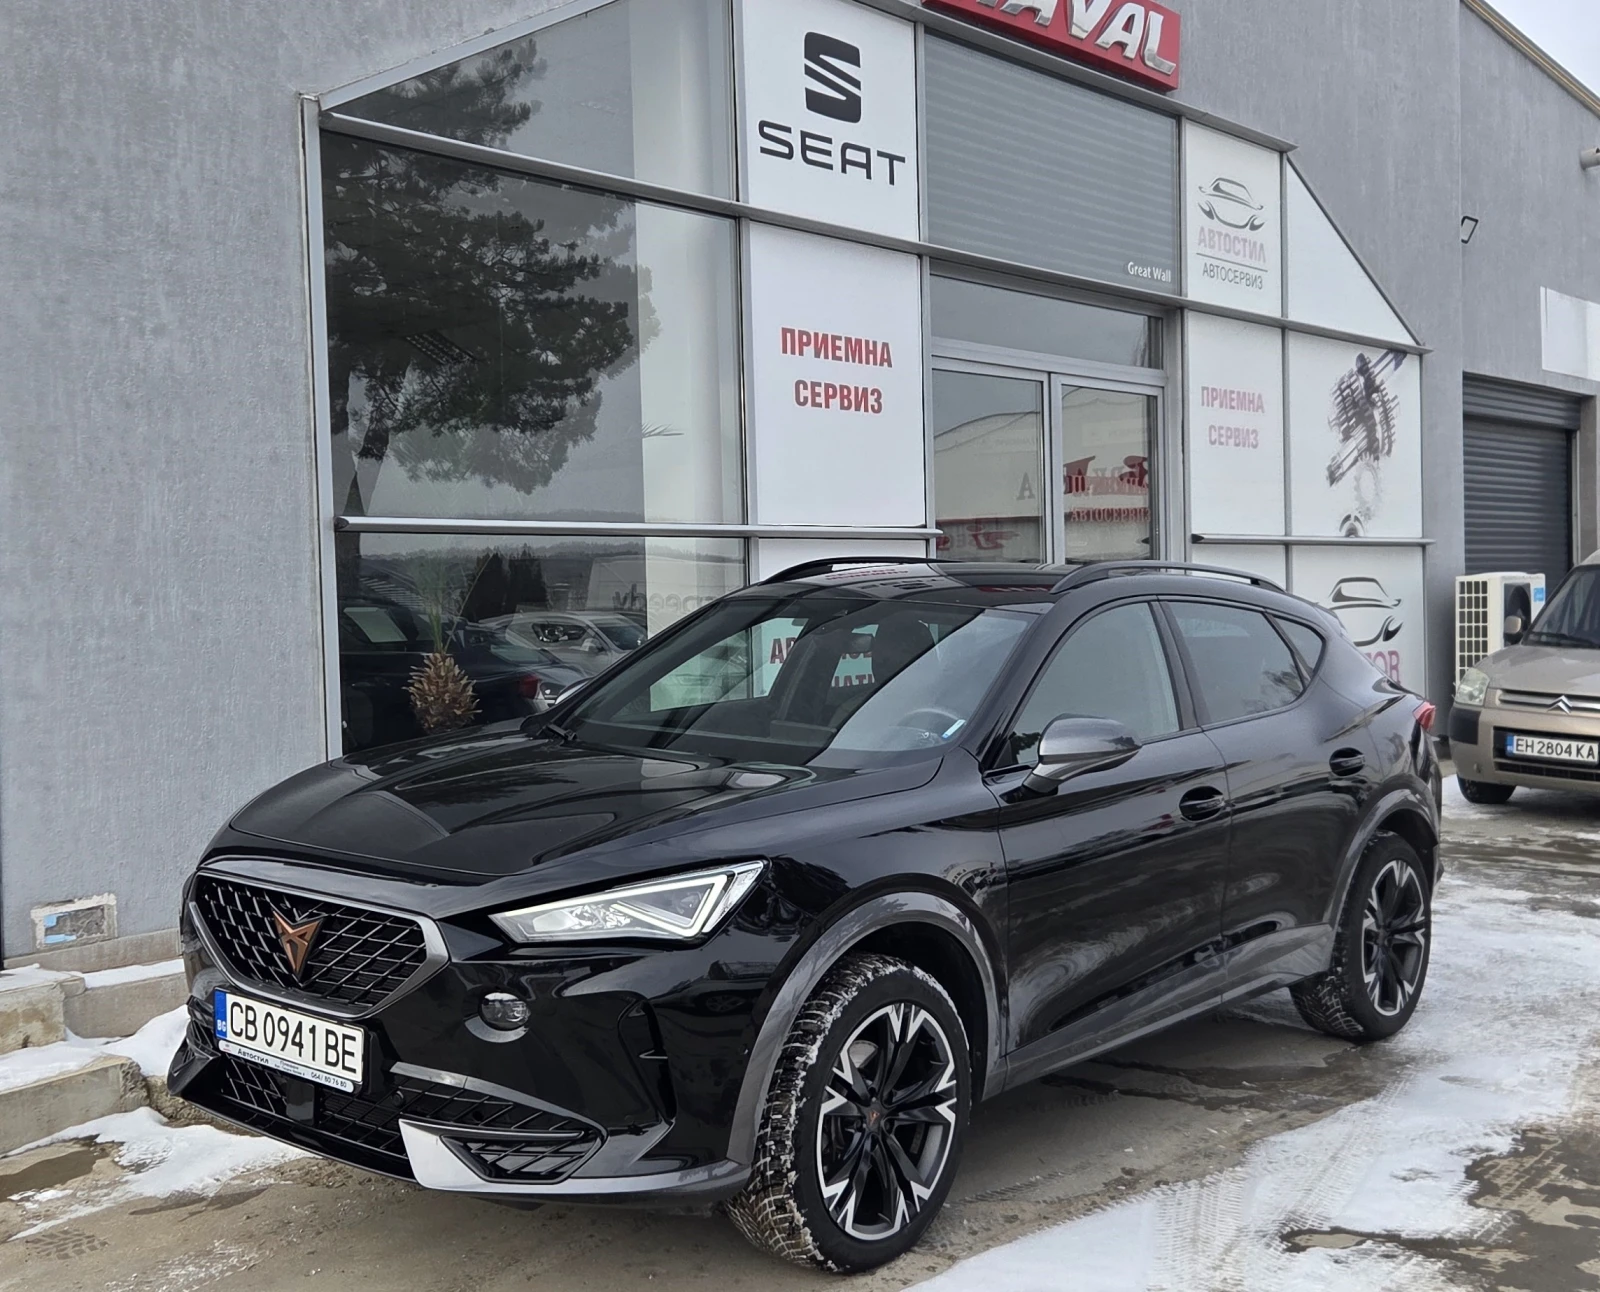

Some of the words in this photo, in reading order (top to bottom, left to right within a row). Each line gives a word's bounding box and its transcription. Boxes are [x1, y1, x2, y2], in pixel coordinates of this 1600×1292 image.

[758, 119, 906, 186] SEAT
[1198, 226, 1266, 263] АВТОСТИЛ
[1127, 261, 1151, 279] Great
[1152, 266, 1171, 283] Wall
[1202, 262, 1263, 290] АВТОСЕРВИЗ
[781, 326, 893, 368] ПРИЕМНА
[794, 379, 883, 414] СЕРВИЗ
[1200, 385, 1265, 414] ПРИЕМНА
[1208, 424, 1259, 449] СЕРВИЗ
